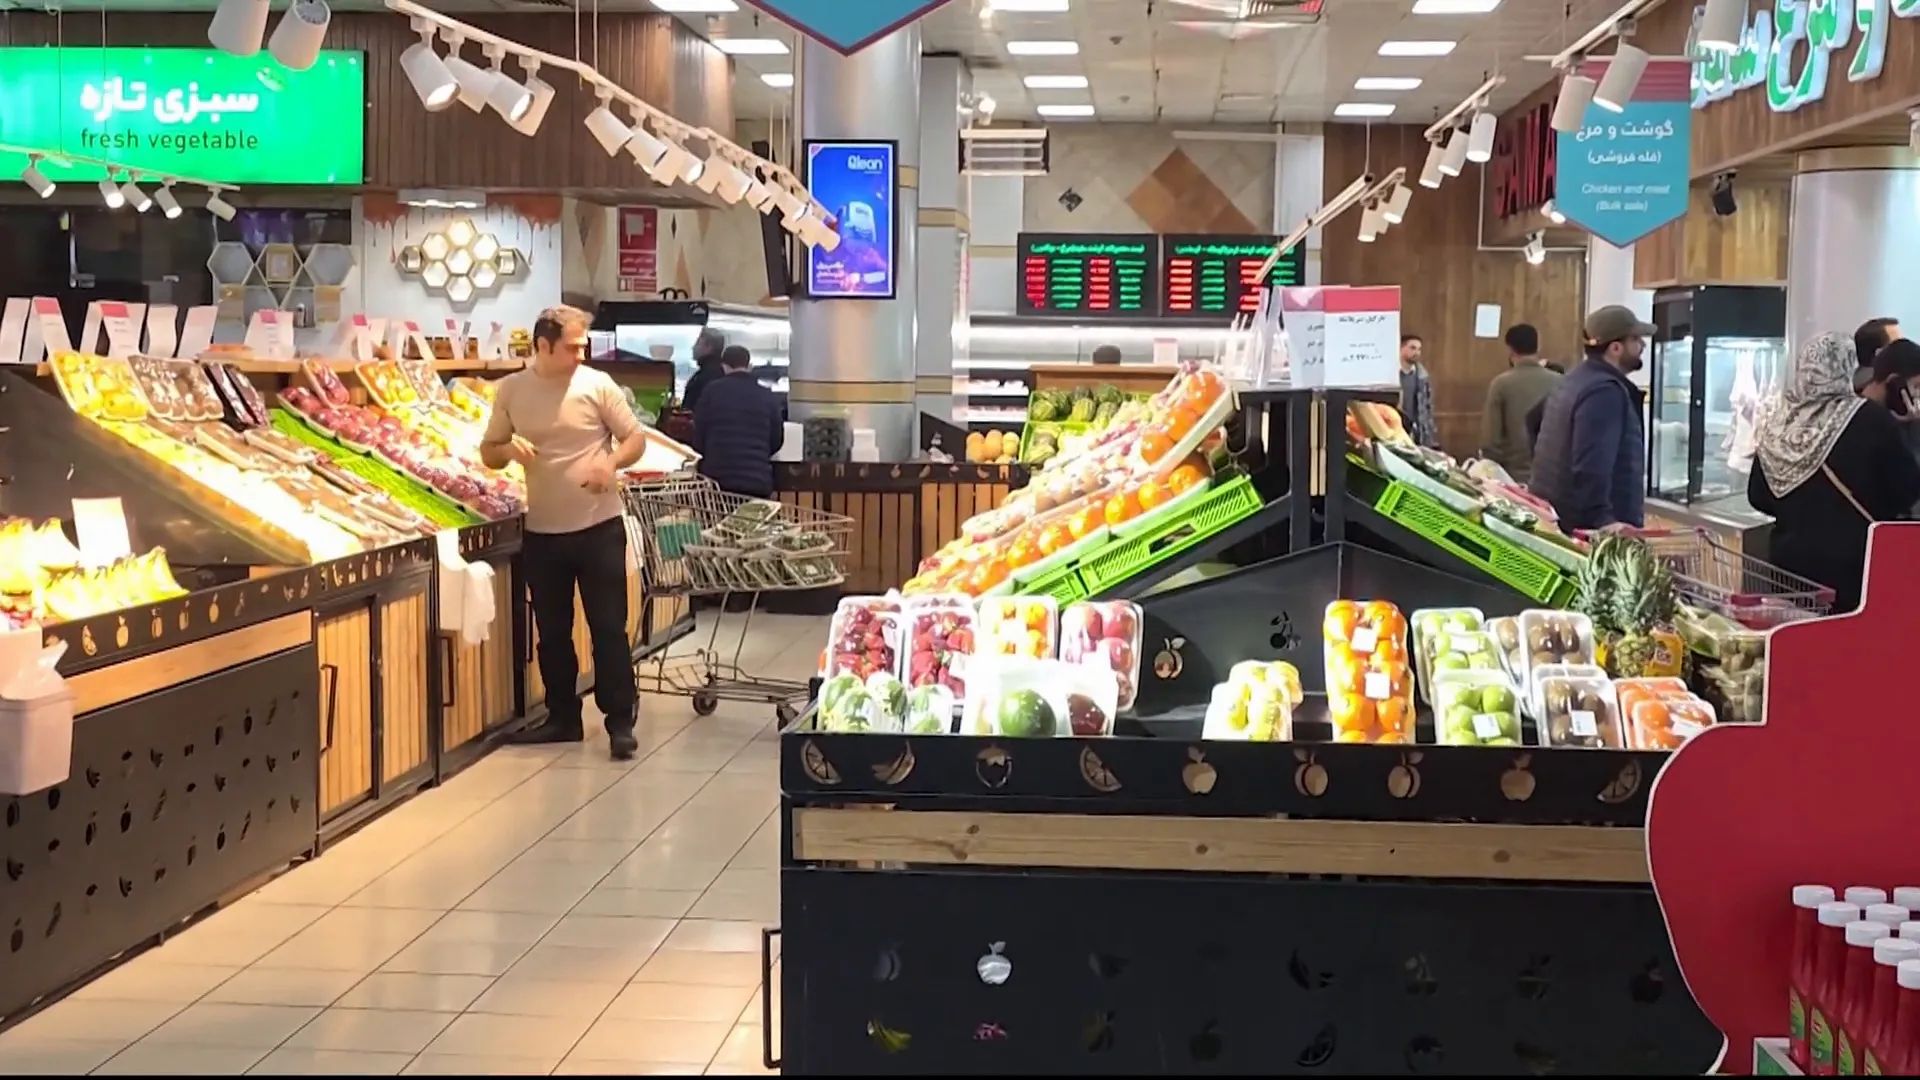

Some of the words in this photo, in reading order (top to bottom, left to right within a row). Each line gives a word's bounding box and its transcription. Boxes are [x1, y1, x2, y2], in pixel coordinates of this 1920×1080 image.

[80, 76, 147, 122] تازه
[153, 81, 259, 124] سبزی
[1576, 123, 1603, 142] مرغ
[1608, 124, 1617, 140] و
[1620, 118, 1674, 140] گوشت
[81, 128, 139, 148] fresh
[148, 129, 258, 154] vegetable
[1582, 183, 1622, 194] Chicken
[1624, 184, 1644, 194] and
